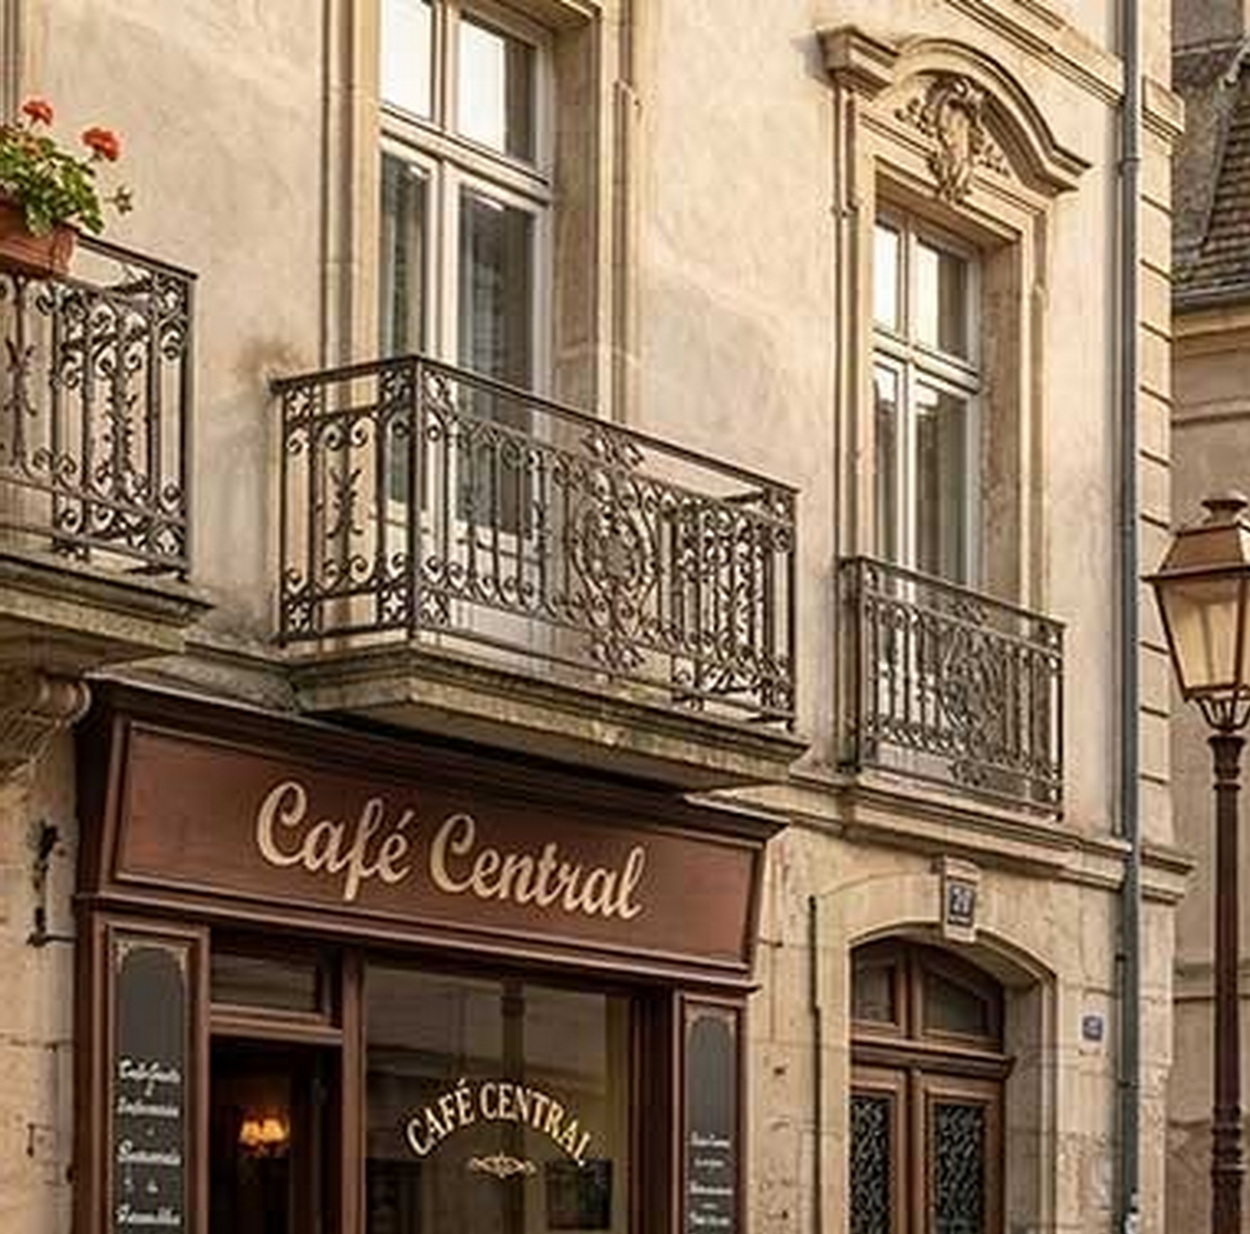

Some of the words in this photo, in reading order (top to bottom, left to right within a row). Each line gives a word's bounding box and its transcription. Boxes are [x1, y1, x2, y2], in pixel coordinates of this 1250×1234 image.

[256, 780, 414, 899] Café
[429, 813, 647, 919] Central
[406, 1078, 475, 1156] CAFÉ
[480, 1083, 591, 1166] CENTRAL
